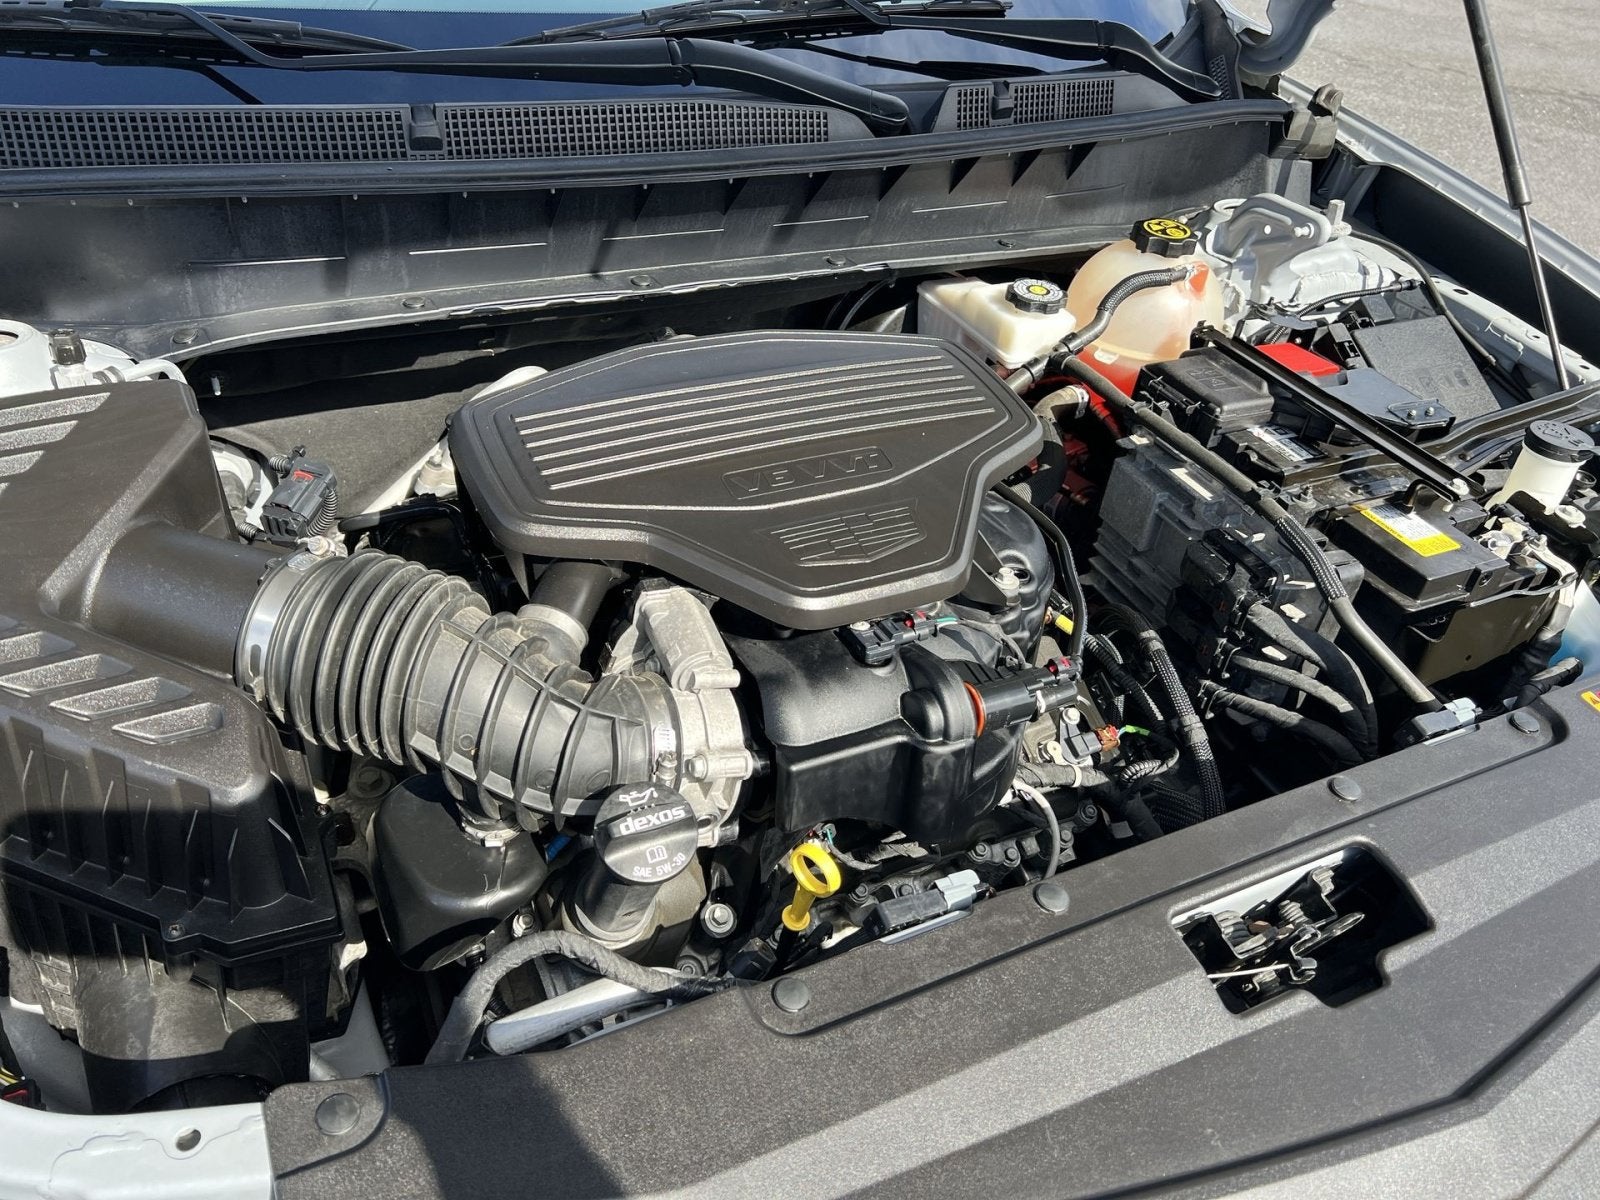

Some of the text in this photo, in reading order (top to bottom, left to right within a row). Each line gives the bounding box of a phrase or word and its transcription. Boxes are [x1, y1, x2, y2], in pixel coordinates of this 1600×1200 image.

[729, 468, 796, 492] V6
[619, 805, 686, 835] dexos
[632, 852, 686, 877] SAE 5W-30
